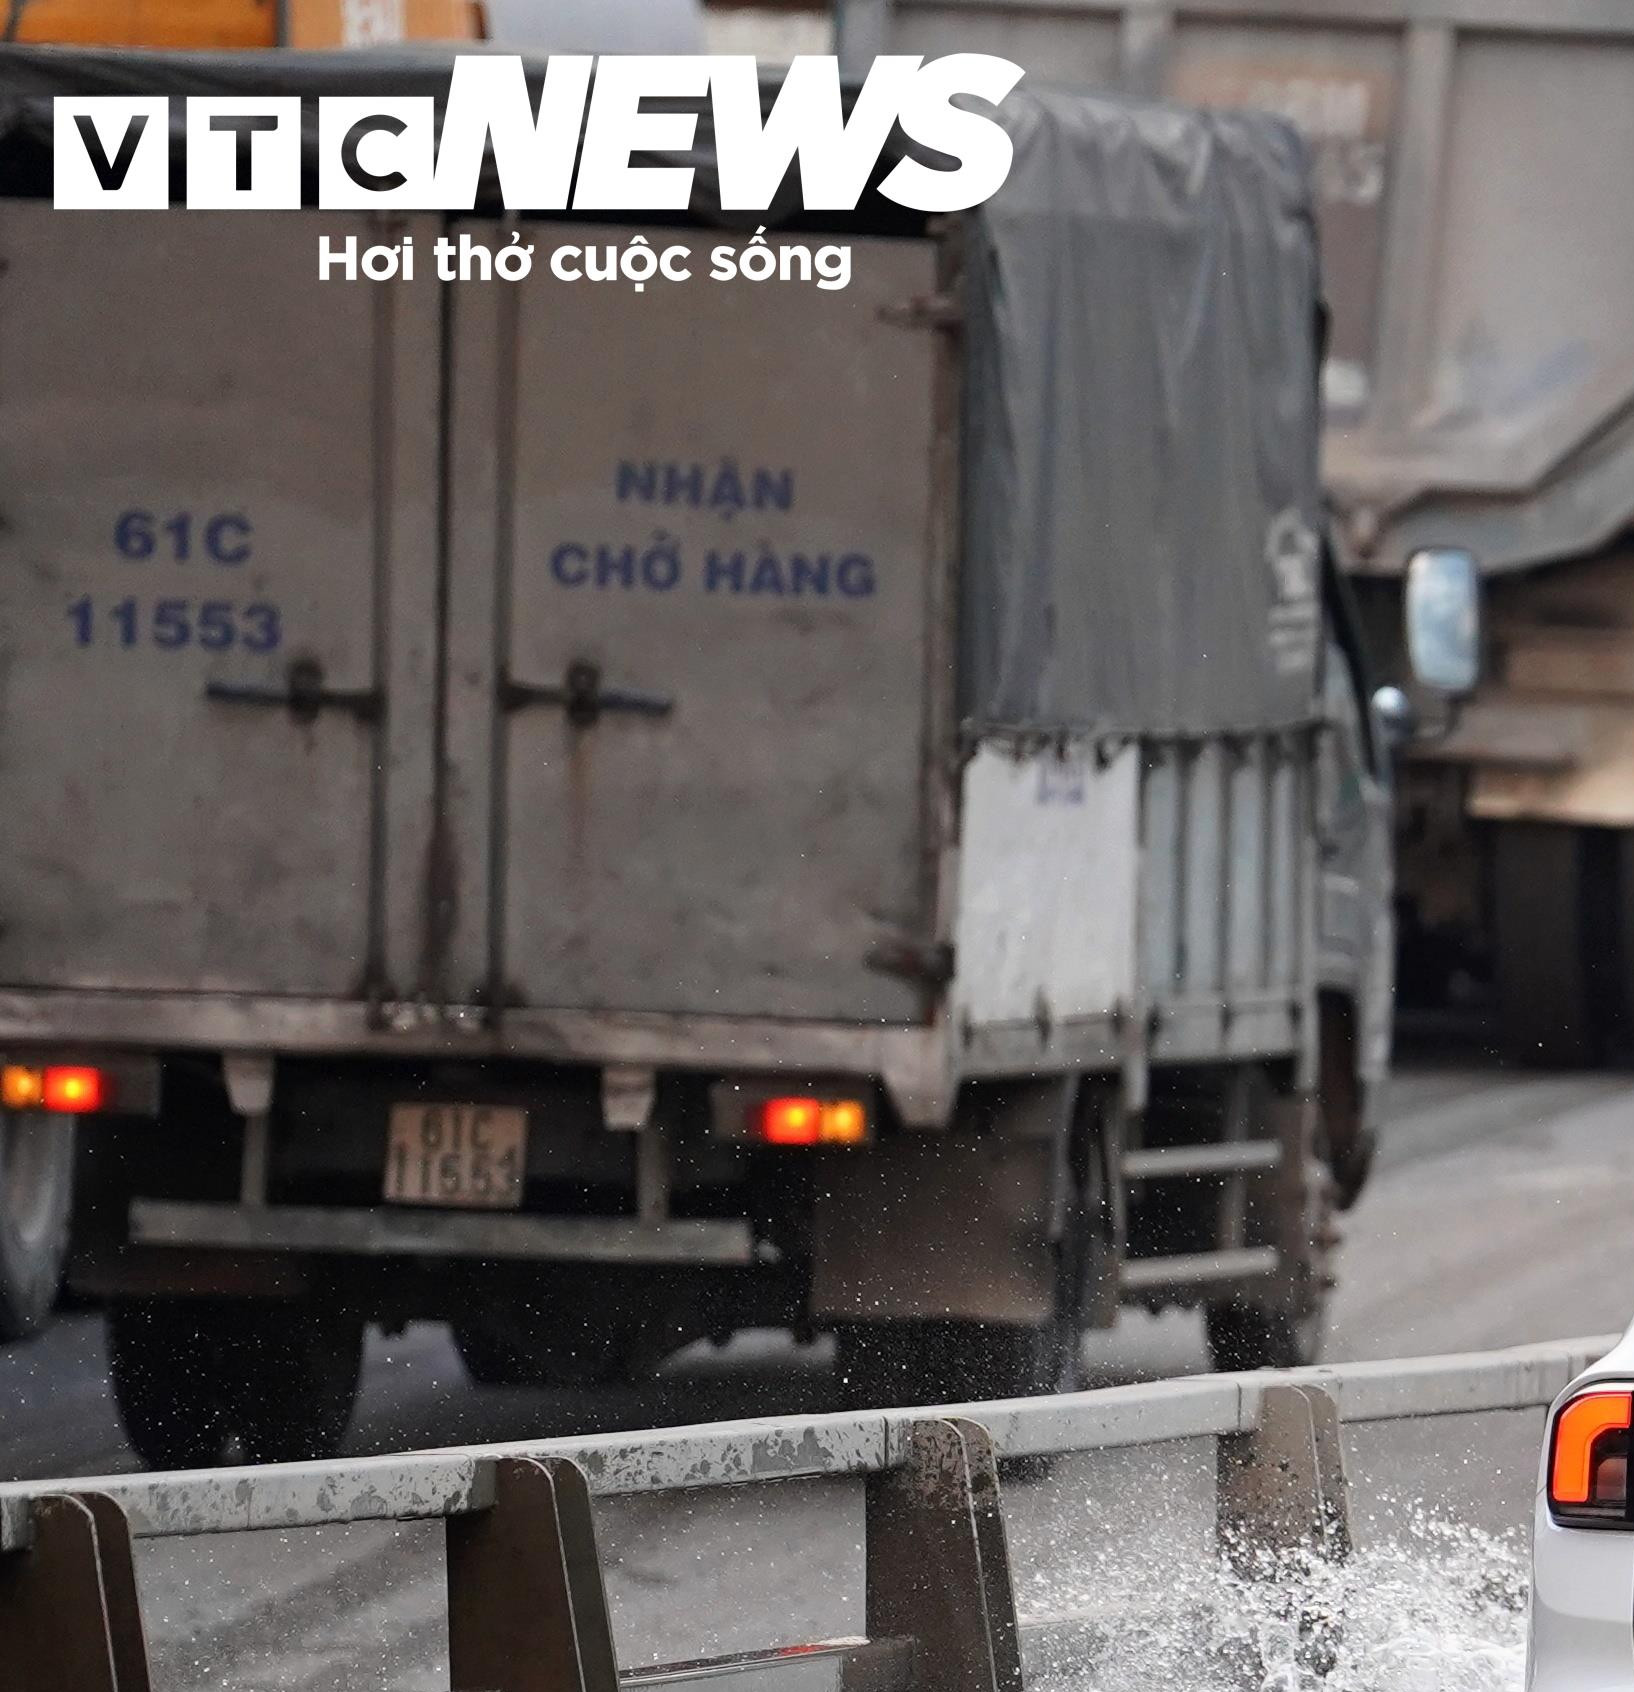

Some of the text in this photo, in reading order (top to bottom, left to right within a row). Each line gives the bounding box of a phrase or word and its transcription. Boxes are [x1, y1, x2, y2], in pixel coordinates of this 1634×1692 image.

[113, 508, 254, 566] 61C
[704, 538, 876, 597] HÀNG
[66, 595, 283, 655] 11553
